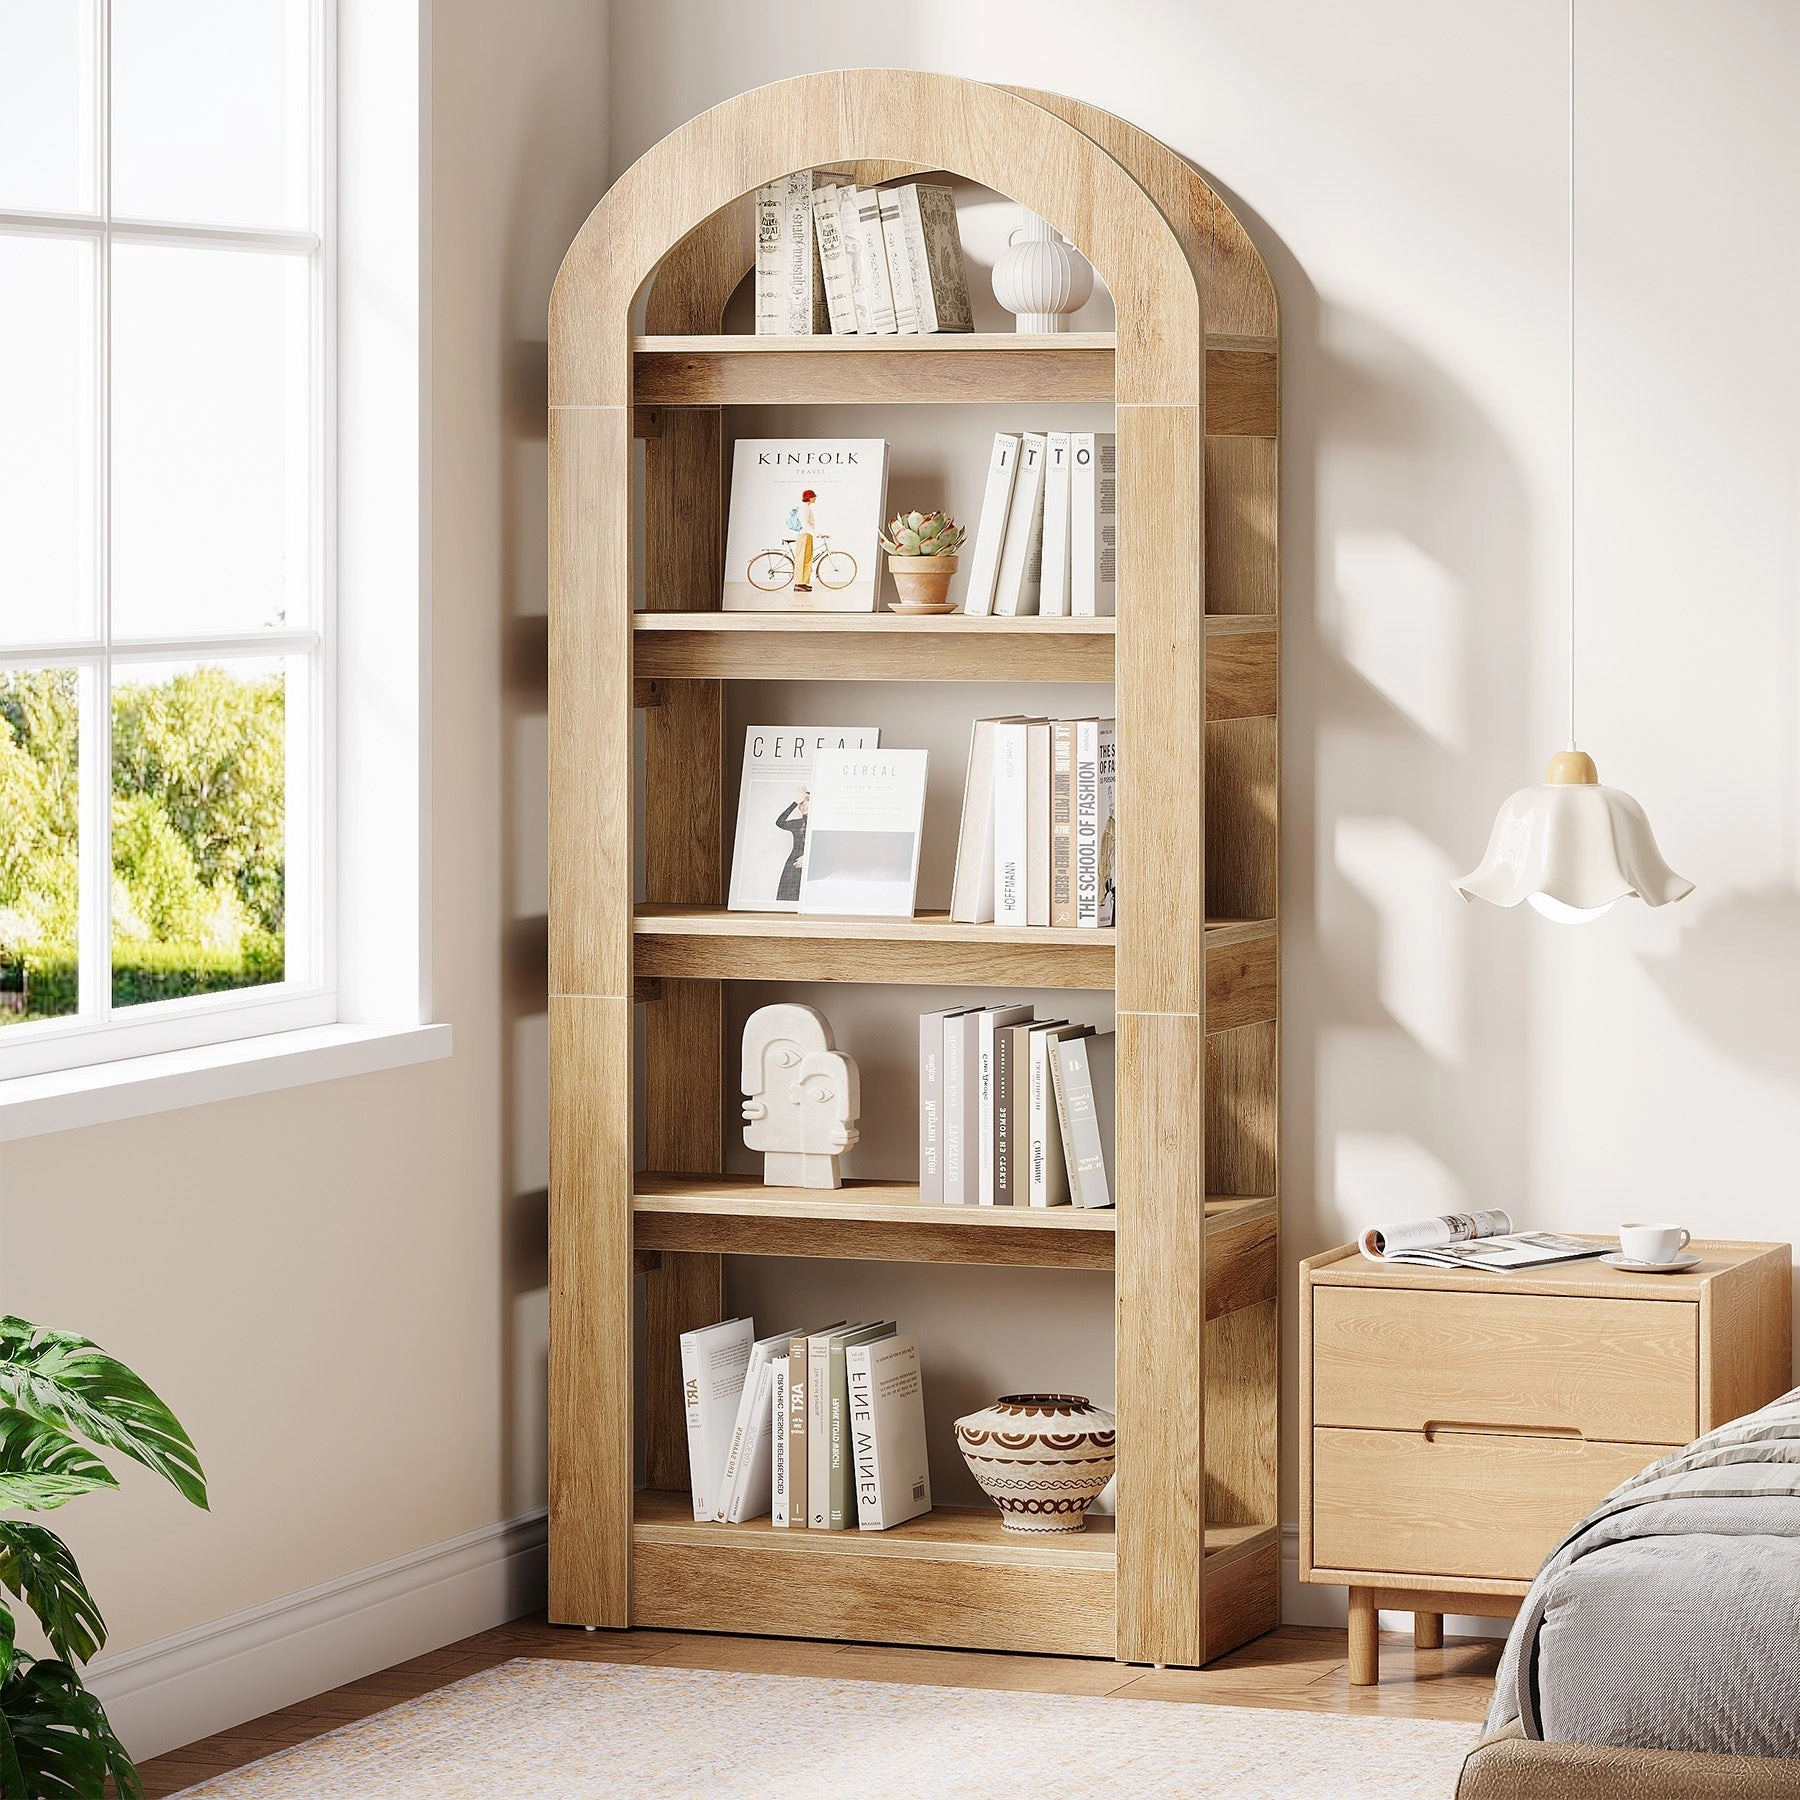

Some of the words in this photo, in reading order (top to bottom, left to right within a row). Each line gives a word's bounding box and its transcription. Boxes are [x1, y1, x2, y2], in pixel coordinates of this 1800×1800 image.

[758, 452, 859, 465] KINFOLK
[1000, 451, 1006, 466] I
[1028, 449, 1037, 465] T
[1055, 448, 1063, 464] T
[1076, 449, 1090, 465] O
[1100, 744, 1110, 759] THE
[842, 764, 896, 777] CEREAL
[1100, 761, 1107, 774] OF
[1055, 774, 1070, 797] HARRY
[1079, 761, 1095, 816] FASHION
[1055, 798, 1070, 823] POTTER
[1079, 820, 1095, 837] OF
[1055, 836, 1070, 869] CHAMBER
[1079, 840, 1095, 891] SCHOOL
[1004, 862, 1016, 911] HOFFMANN
[1055, 875, 1070, 904] SECRETS
[1079, 894, 1095, 919] THE
